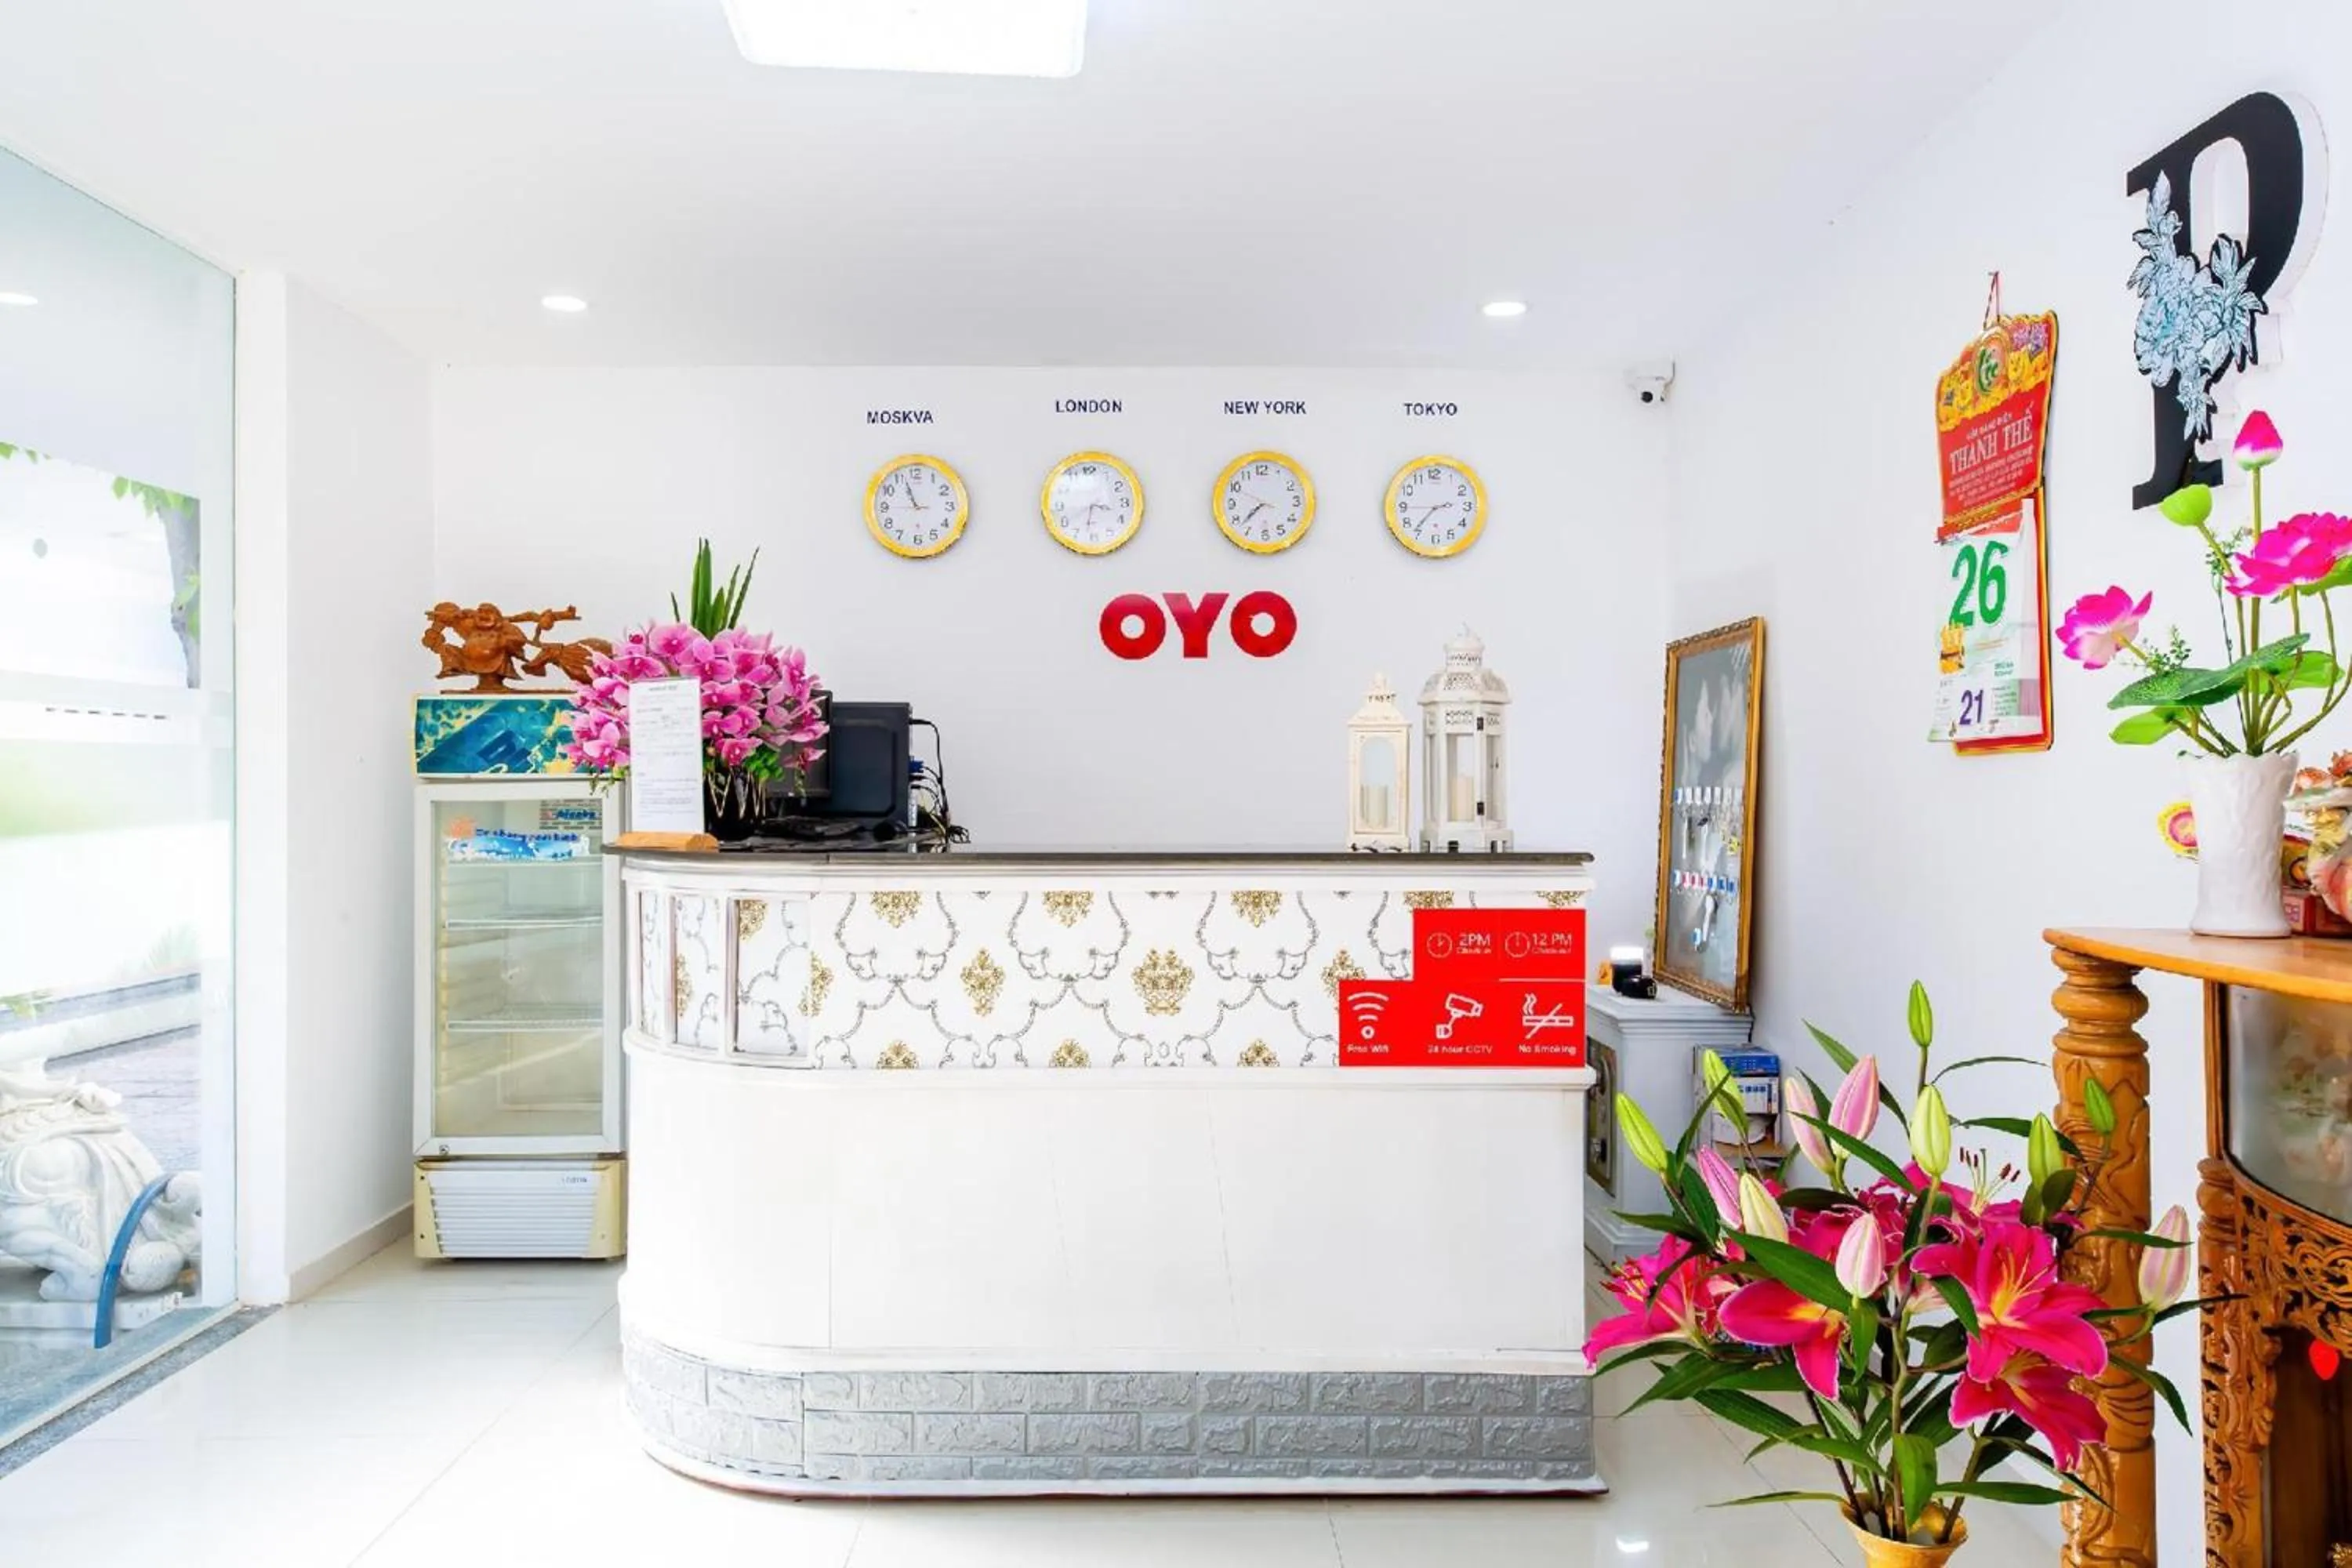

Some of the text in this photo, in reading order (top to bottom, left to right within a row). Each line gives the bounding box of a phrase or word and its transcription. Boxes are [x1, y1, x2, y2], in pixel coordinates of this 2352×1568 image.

[1056, 399, 1122, 413] LONDON
[1224, 401, 1307, 415] NEW YORK
[1403, 402, 1457, 416] TOKYO
[866, 410, 934, 424] MOSKVA
[1949, 430, 1998, 475] THANH
[909, 468, 922, 480] 12
[1241, 470, 1250, 481] 11
[1255, 464, 1269, 476] 12
[1428, 468, 1441, 480] 12
[895, 473, 904, 485] 11
[1414, 474, 1423, 485] 11
[882, 484, 895, 497] 10
[938, 484, 949, 496] 2
[1114, 480, 1123, 492] 2
[1230, 481, 1241, 493] 10
[1286, 479, 1295, 492] 2
[1402, 483, 1414, 496] 10
[1457, 484, 1467, 496] 2
[945, 501, 956, 512] 3
[1120, 497, 1130, 508] 3
[1228, 498, 1236, 510] 9
[1292, 495, 1301, 507] 3
[1398, 501, 1408, 513] 9
[1462, 501, 1472, 512] 3
[880, 501, 890, 514] 9
[884, 517, 893, 529] 8
[941, 517, 949, 528] 4
[1457, 517, 1467, 528] 4
[895, 529, 904, 540] 7
[929, 528, 938, 541] 5
[1261, 529, 1270, 541] 6
[1276, 524, 1286, 536] 5
[913, 535, 923, 546] 6
[1949, 541, 2009, 630] 26
[1099, 590, 1298, 660] OYO
[1958, 689, 1984, 725] 21
[1458, 932, 1491, 946] 2PM
[1532, 932, 1572, 946] 12 PM
[1347, 1044, 1368, 1054] Free
[1441, 1044, 1464, 1054] hour
[1465, 1044, 1494, 1054] CCTV
[1518, 1044, 1577, 1056] No Smoking
